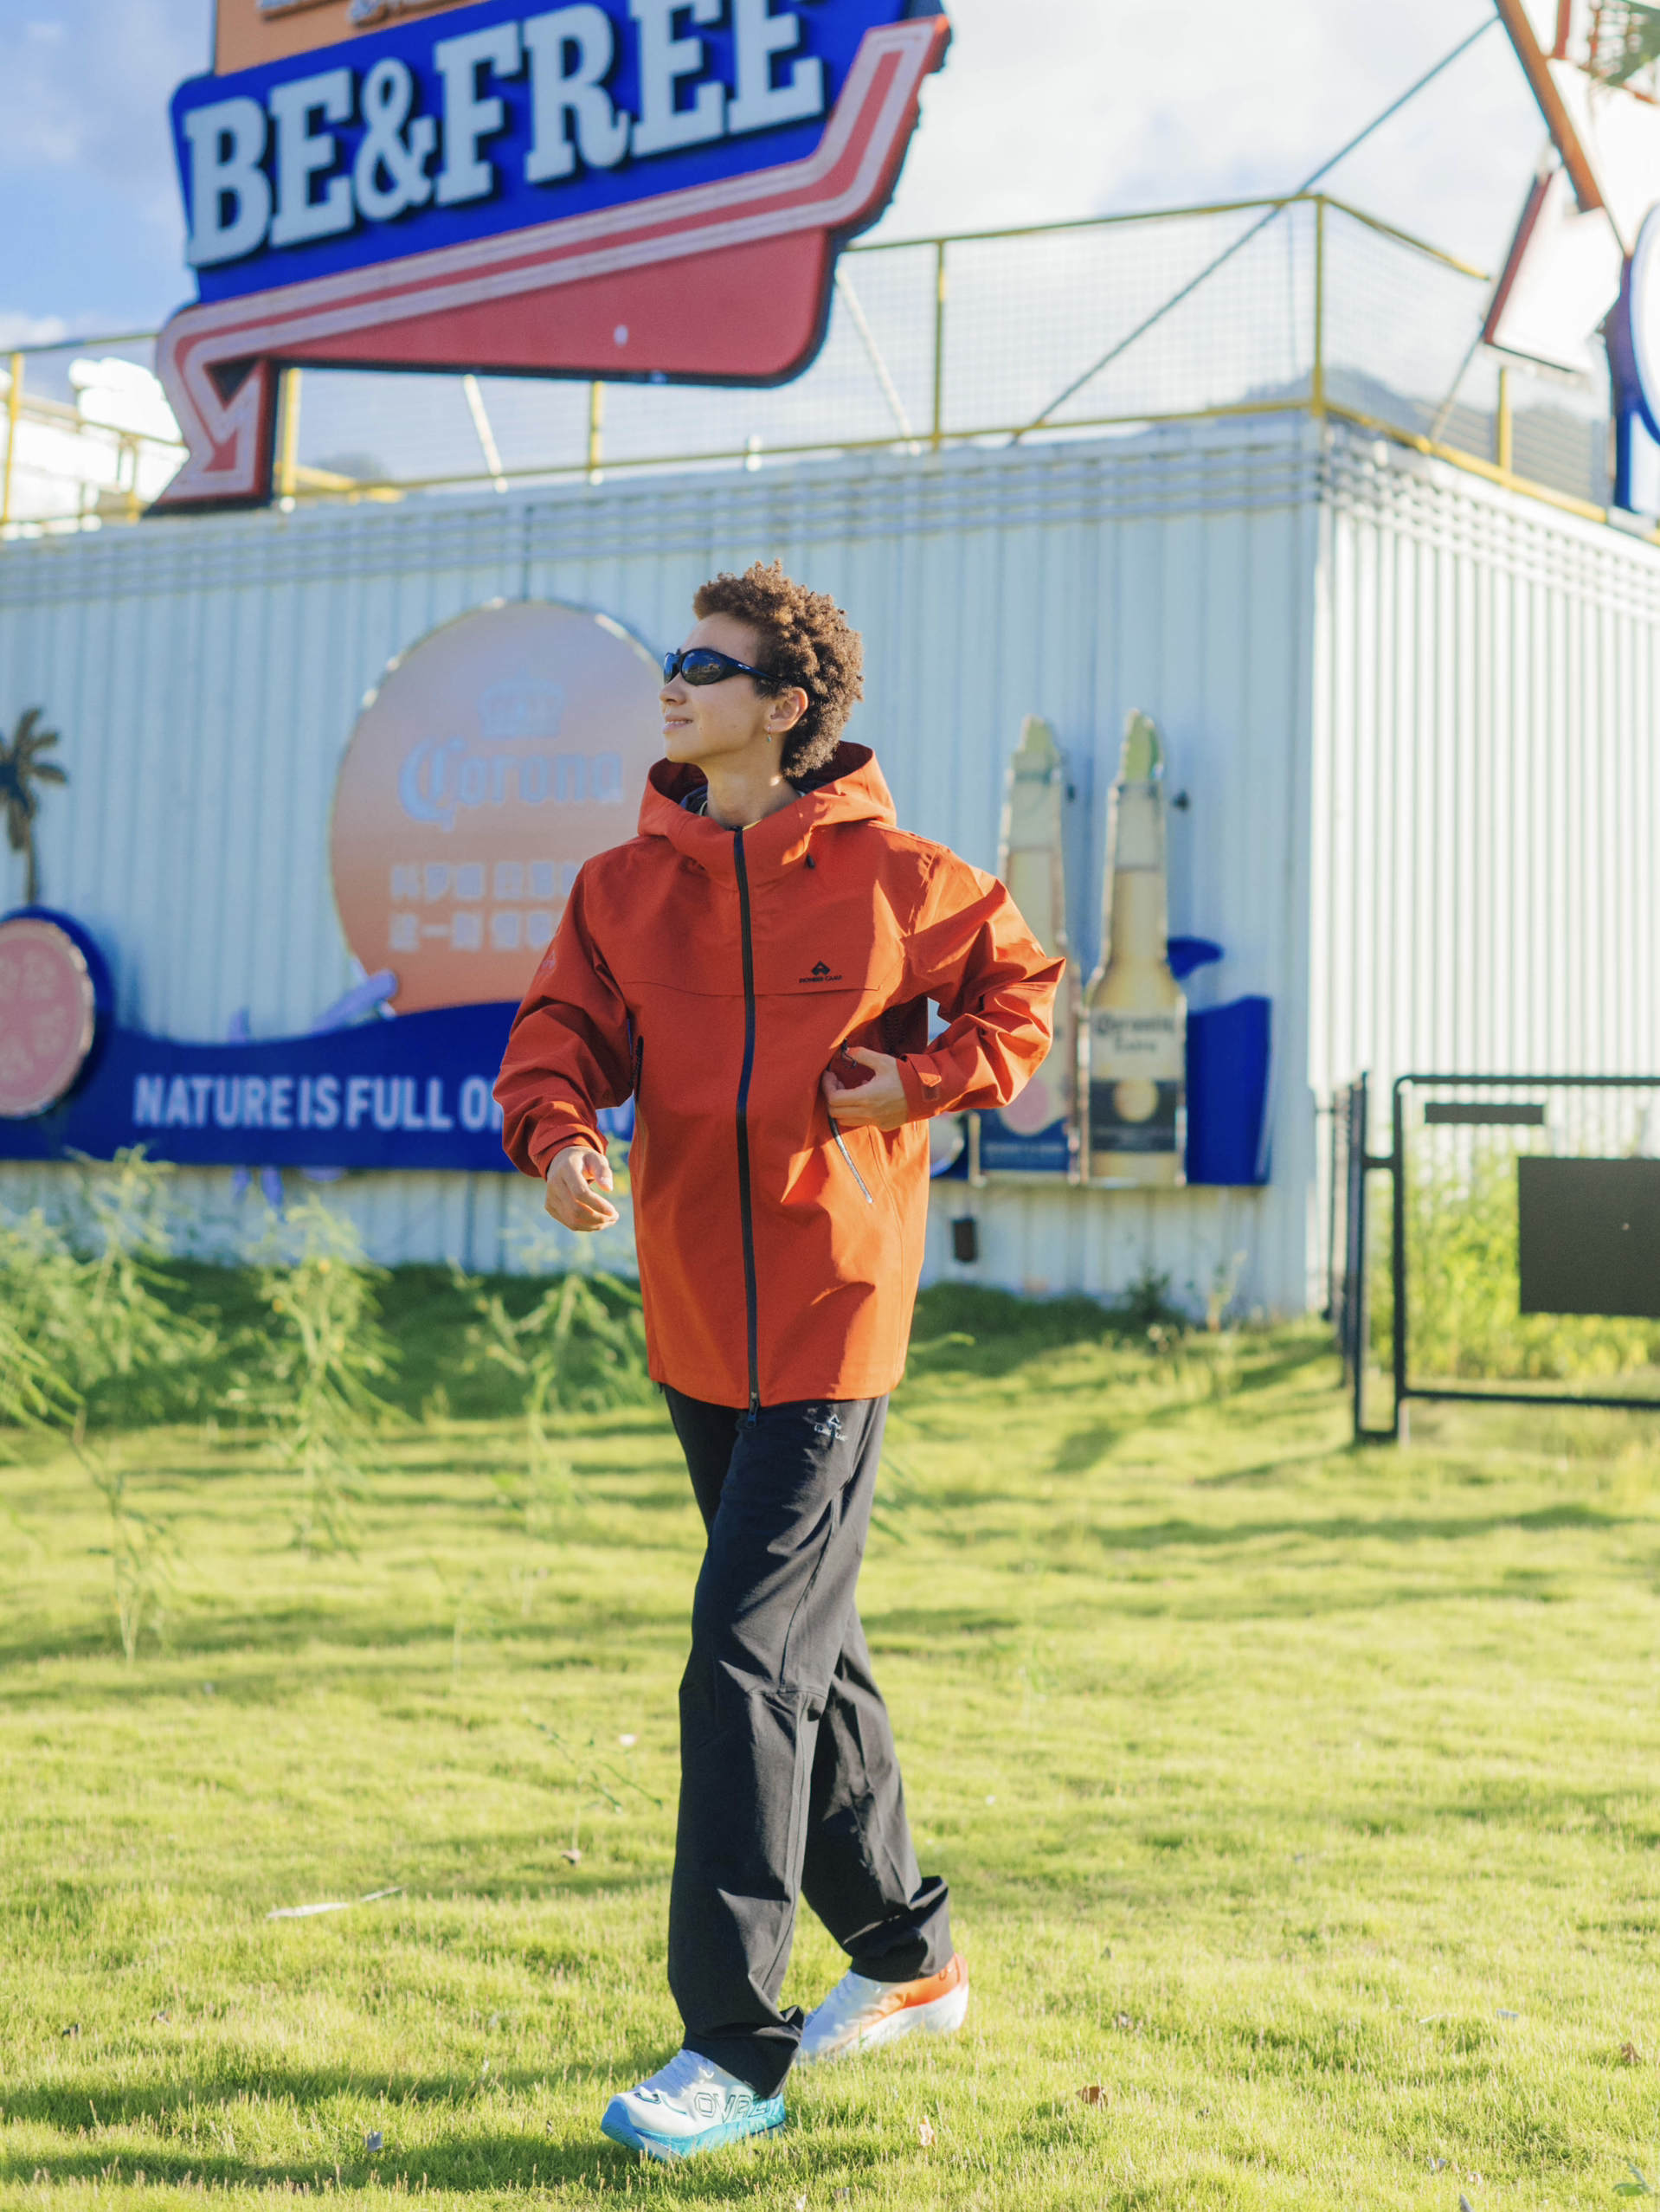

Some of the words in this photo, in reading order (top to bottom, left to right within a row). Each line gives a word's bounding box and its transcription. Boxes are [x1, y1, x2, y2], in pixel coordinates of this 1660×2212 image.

[183, 0, 824, 267] BE&FREE
[397, 736, 625, 831] Corona
[133, 1075, 293, 1128] NATURE
[299, 1075, 339, 1129] IS
[347, 1077, 453, 1130] FULL
